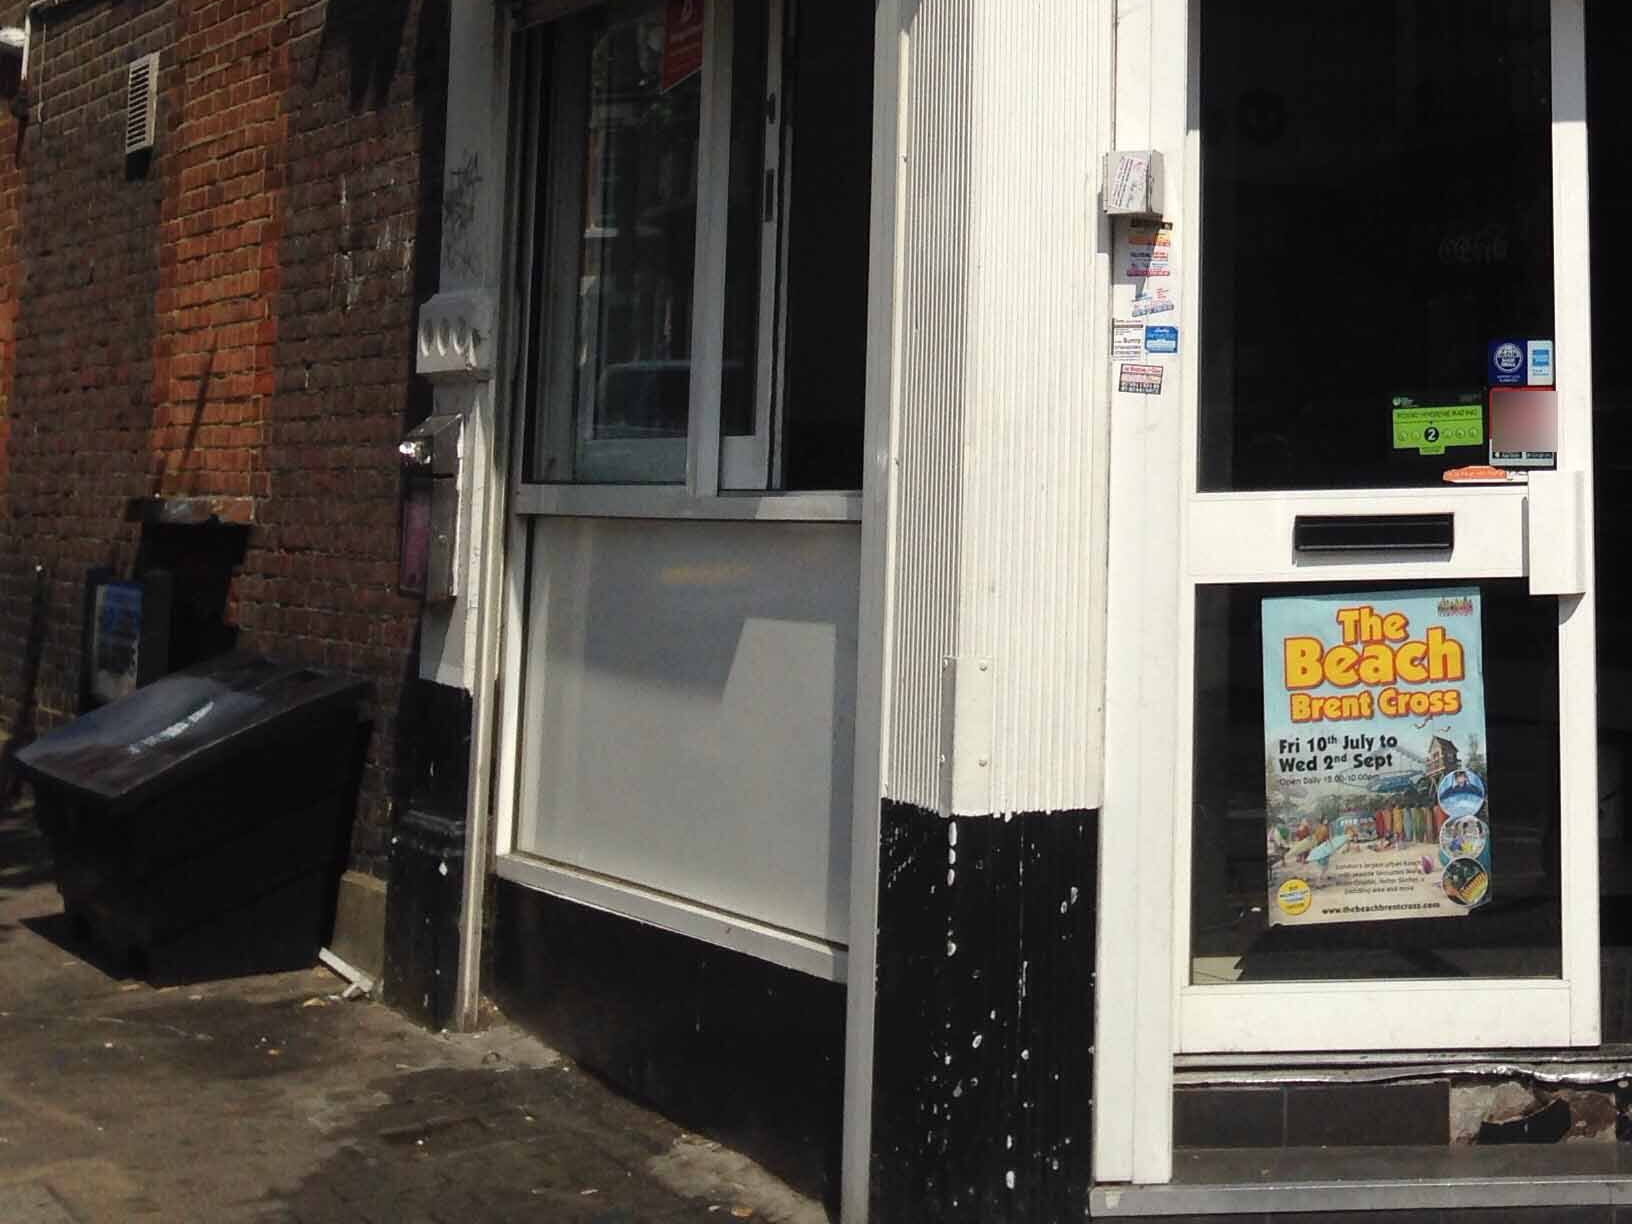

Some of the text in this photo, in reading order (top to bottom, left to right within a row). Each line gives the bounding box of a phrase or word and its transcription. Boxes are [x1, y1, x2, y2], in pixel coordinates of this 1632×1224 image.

[1427, 428, 1436, 441] 2
[1336, 605, 1409, 645] The
[1283, 626, 1465, 690] Beach
[1289, 686, 1462, 723] Brent Cross
[1279, 734, 1398, 753] Fri 10th July to
[1279, 753, 1393, 772] Wed 2nd Sept
